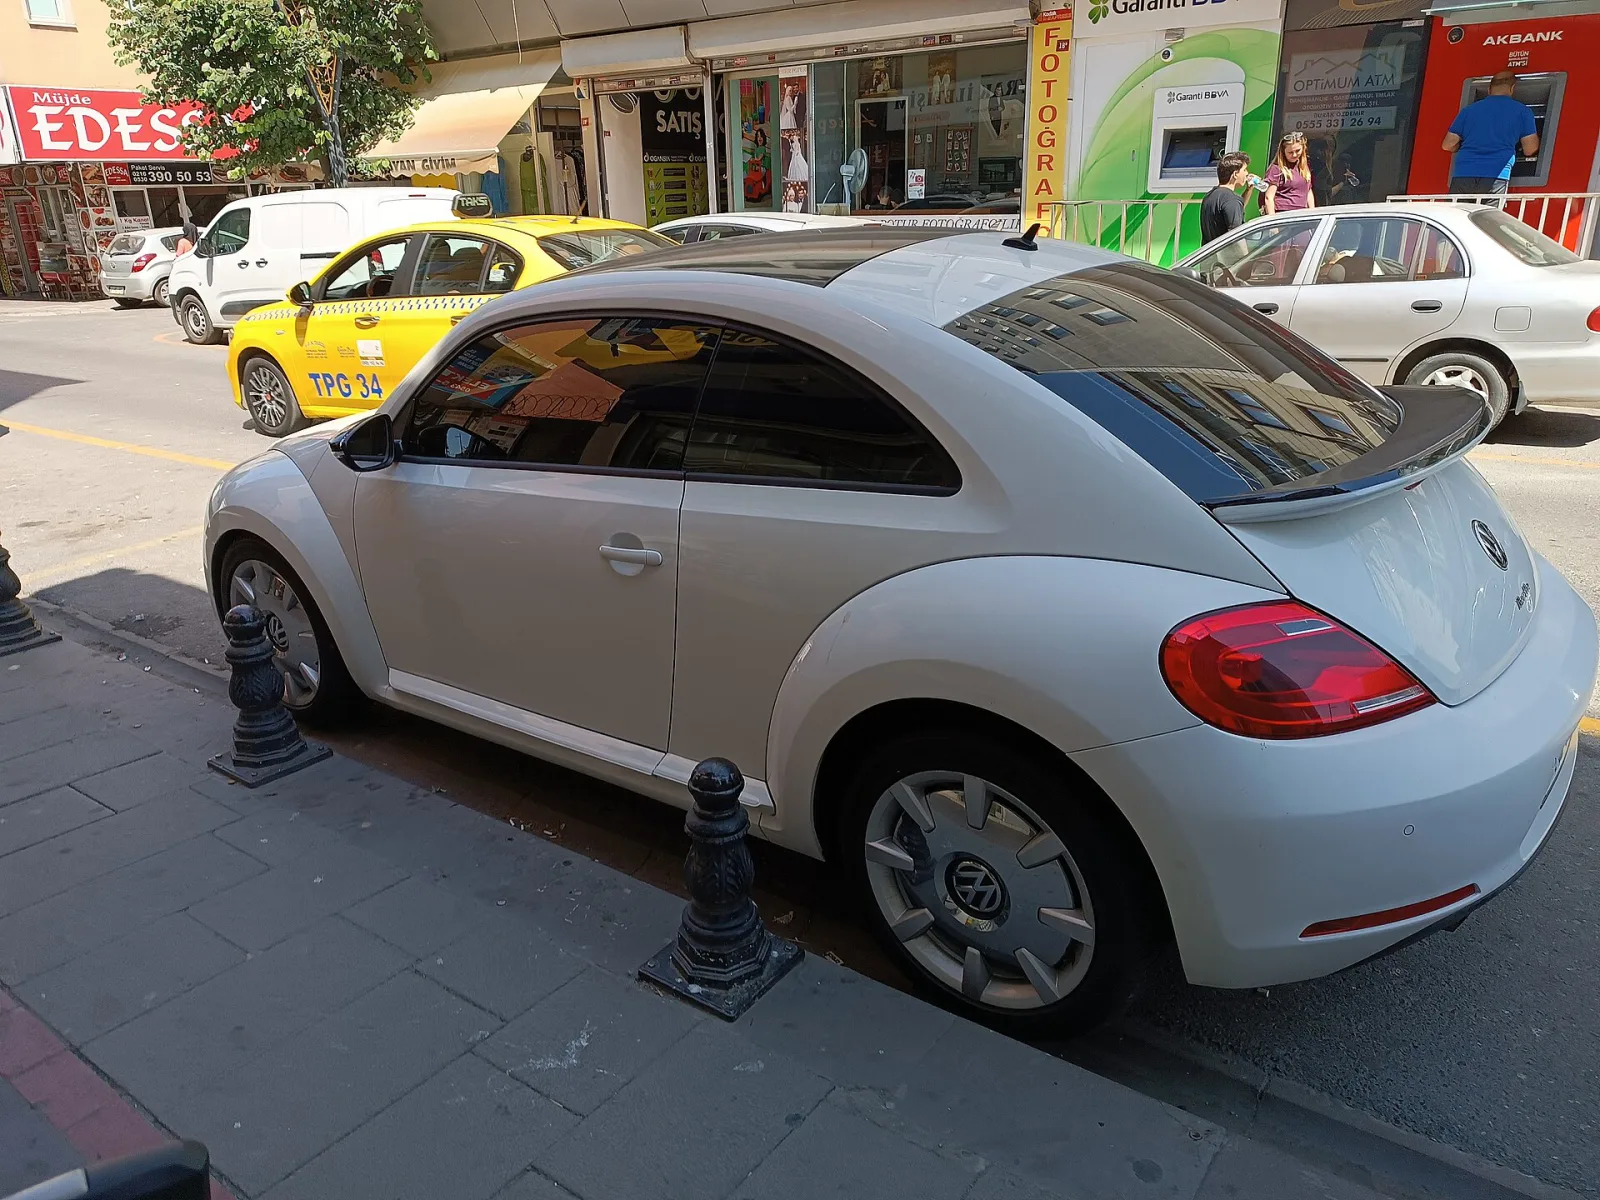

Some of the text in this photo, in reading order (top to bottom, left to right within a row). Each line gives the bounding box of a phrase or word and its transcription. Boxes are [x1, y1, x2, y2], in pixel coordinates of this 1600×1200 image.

[1482, 30, 1564, 46] AKBANK
[1364, 73, 1395, 87] ATM
[32, 91, 92, 107] Müjde
[1175, 89, 1229, 101] Garanti BBVA
[656, 109, 702, 140] SATIŞ
[1295, 116, 1381, 129] 0555 331 26 94
[421, 156, 457, 171] GİYİM
[104, 166, 130, 177] EDESSA
[147, 171, 172, 182] 390
[176, 171, 192, 182] 50
[196, 171, 211, 182] 53
[308, 373, 384, 399] TPG 34
